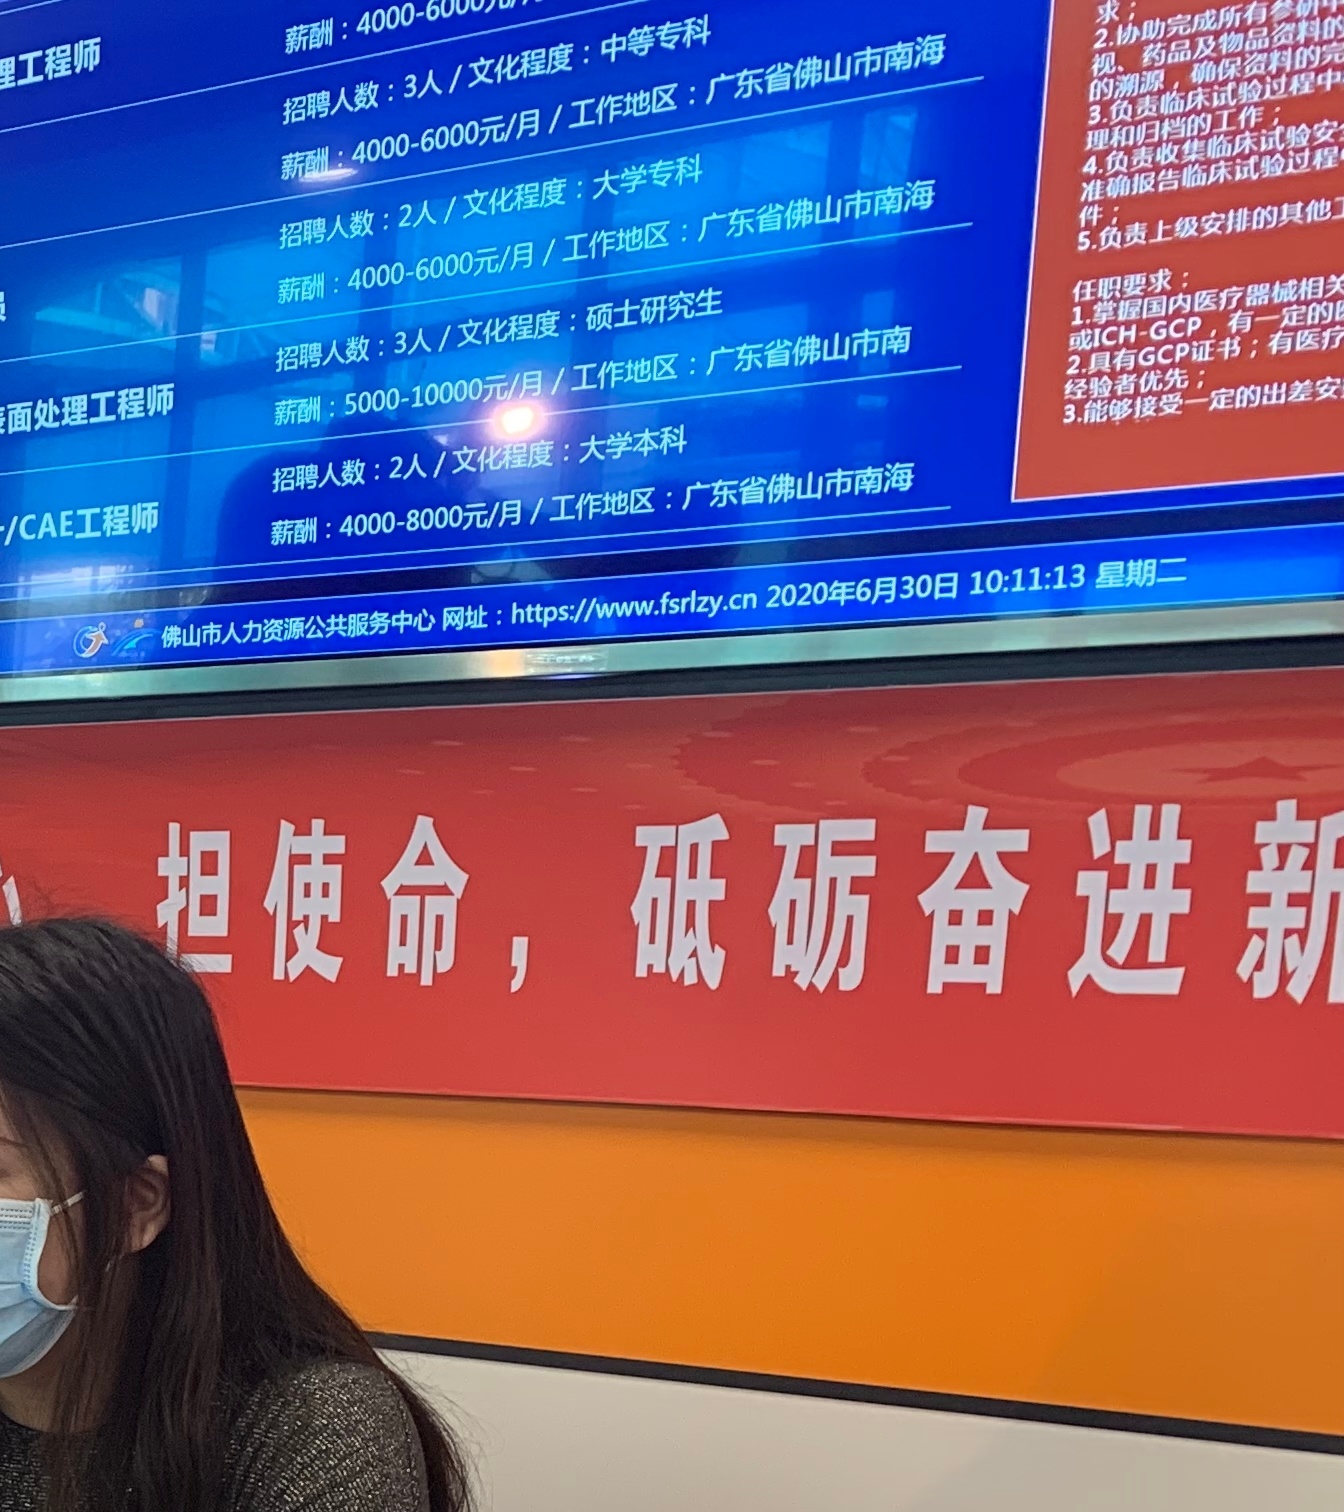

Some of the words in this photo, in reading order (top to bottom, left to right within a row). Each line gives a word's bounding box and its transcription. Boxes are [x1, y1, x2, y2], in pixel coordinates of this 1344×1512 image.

[285, 0, 544, 54] 薪酬：4000-6000
[1092, 0, 1344, 49] 2.协助完成所有参研
[283, 70, 444, 125] 招聘人数：3人
[467, 15, 712, 88] 文化程度：中等专科
[570, 34, 946, 130] 工作地区：广东省佛山市南海
[1088, 68, 1344, 126] 3.负责临床试验过程中
[1082, 118, 1344, 177] 4.负责收集临床试验安
[1085, 105, 1281, 152] 理和归档的工作；
[279, 203, 437, 250] 招聘人数：2人
[463, 154, 702, 219] 文化程度：大学专科
[1080, 146, 1344, 203] 准确报告临床试验过程
[562, 179, 936, 263] 工作地区：广东省佛山市南海
[1072, 268, 1189, 303] 任职要求：
[275, 331, 432, 372] 招聘人数：3人
[458, 287, 723, 347] 文化程度：硕士研究生
[571, 325, 912, 392] 工作地区：广东省佛山市南
[1063, 376, 1344, 424] 3.能够接受一定的出差安
[1064, 367, 1205, 401] 经验者优先；
[272, 453, 427, 494] 招聘人数：2人
[452, 426, 687, 477] 文化程度：大学本科
[271, 500, 523, 547] 薪酬：4000-8000元/月
[549, 462, 914, 524] 工作地区：广东省佛山市南海
[161, 608, 436, 649] 佛山市人力资源公共服务中心
[766, 572, 959, 608] 2020年6月30日
[970, 564, 1086, 596] 10:11:13
[1096, 557, 1188, 590] 星期二
